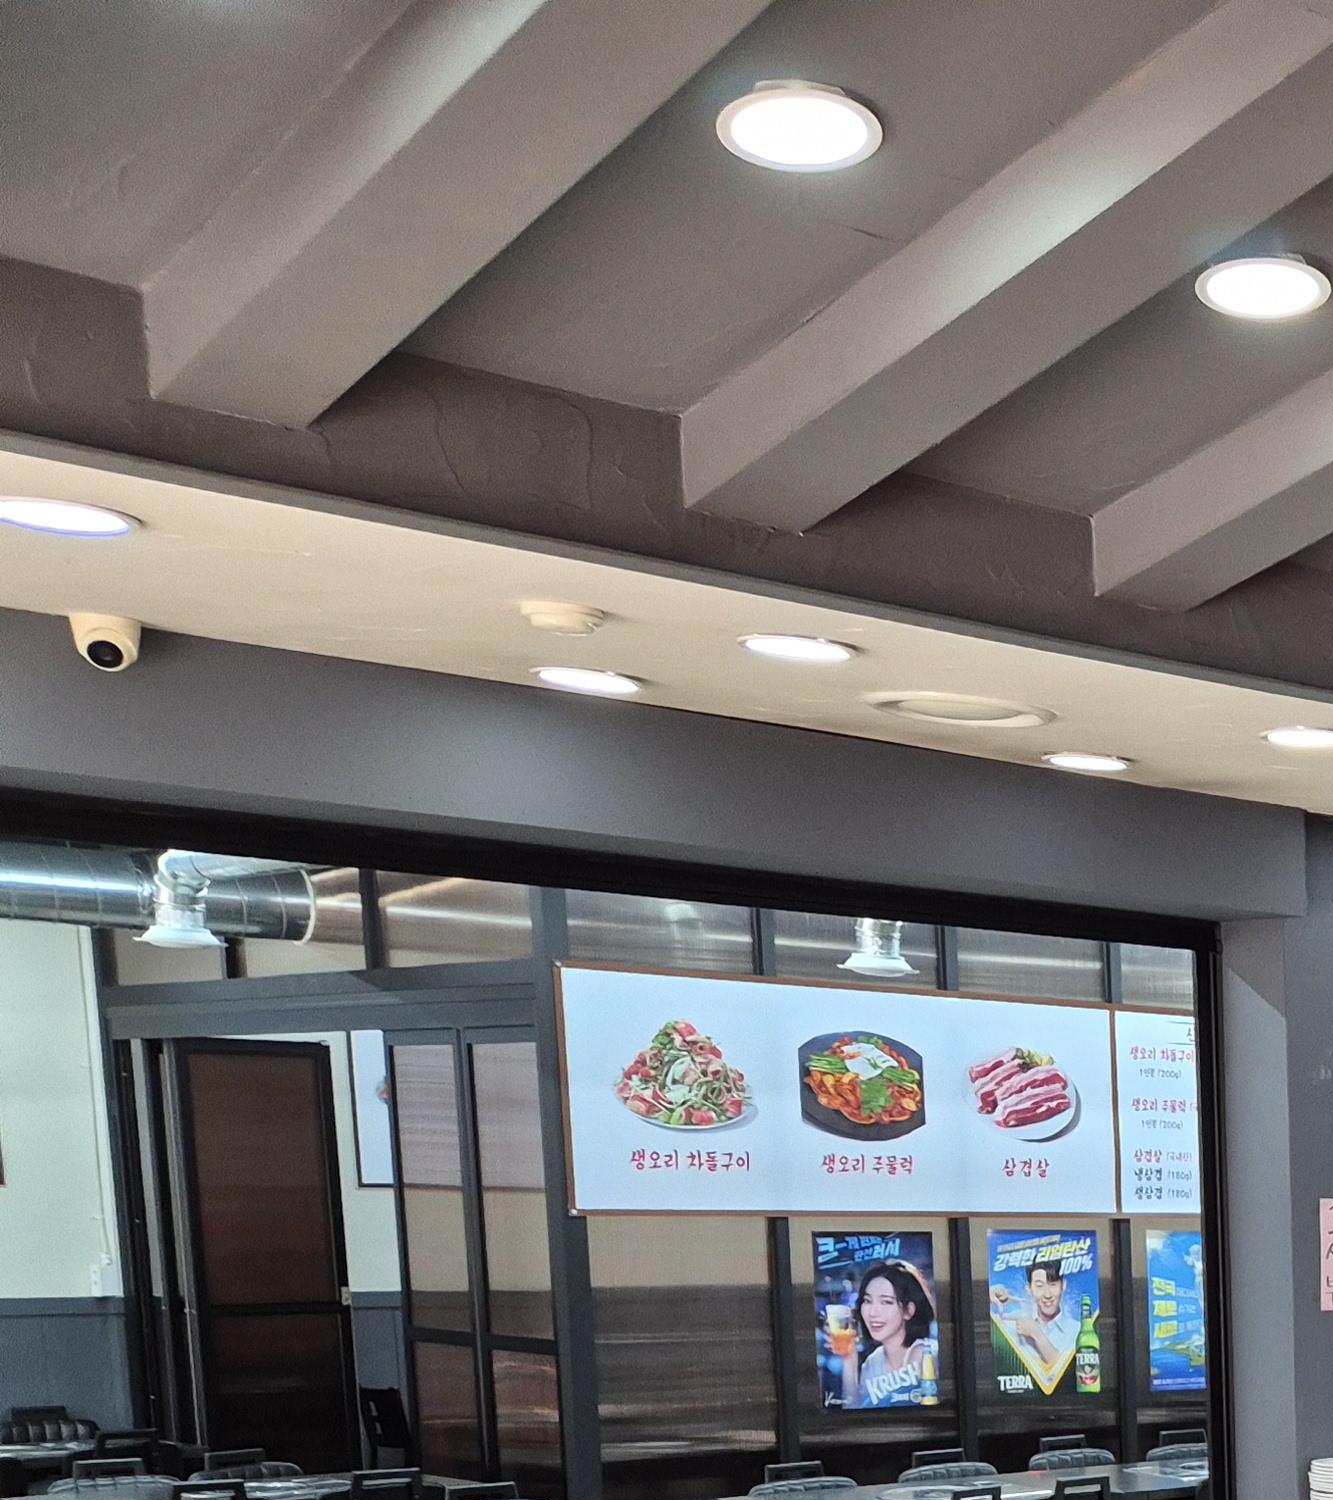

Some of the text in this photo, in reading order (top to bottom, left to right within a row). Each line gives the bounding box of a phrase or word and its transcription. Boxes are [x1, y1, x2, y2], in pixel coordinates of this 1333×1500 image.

[1130, 1046, 1156, 1061] 생오리
[1132, 1098, 1157, 1112] 생오리
[629, 1149, 751, 1172] 생오리 차돌구이
[821, 1154, 914, 1175] 생오리 주물럭
[1002, 1157, 1049, 1178] 삼겹살
[1167, 1169, 1192, 1181] (180g)
[1167, 1187, 1193, 1199] (180g)
[994, 1248, 1036, 1272] 강력한
[1036, 1238, 1091, 1263] 리얼탄산
[1059, 1253, 1093, 1276] 100%
[865, 1361, 922, 1405] KRUSH
[997, 1375, 1034, 1392] TERRA
